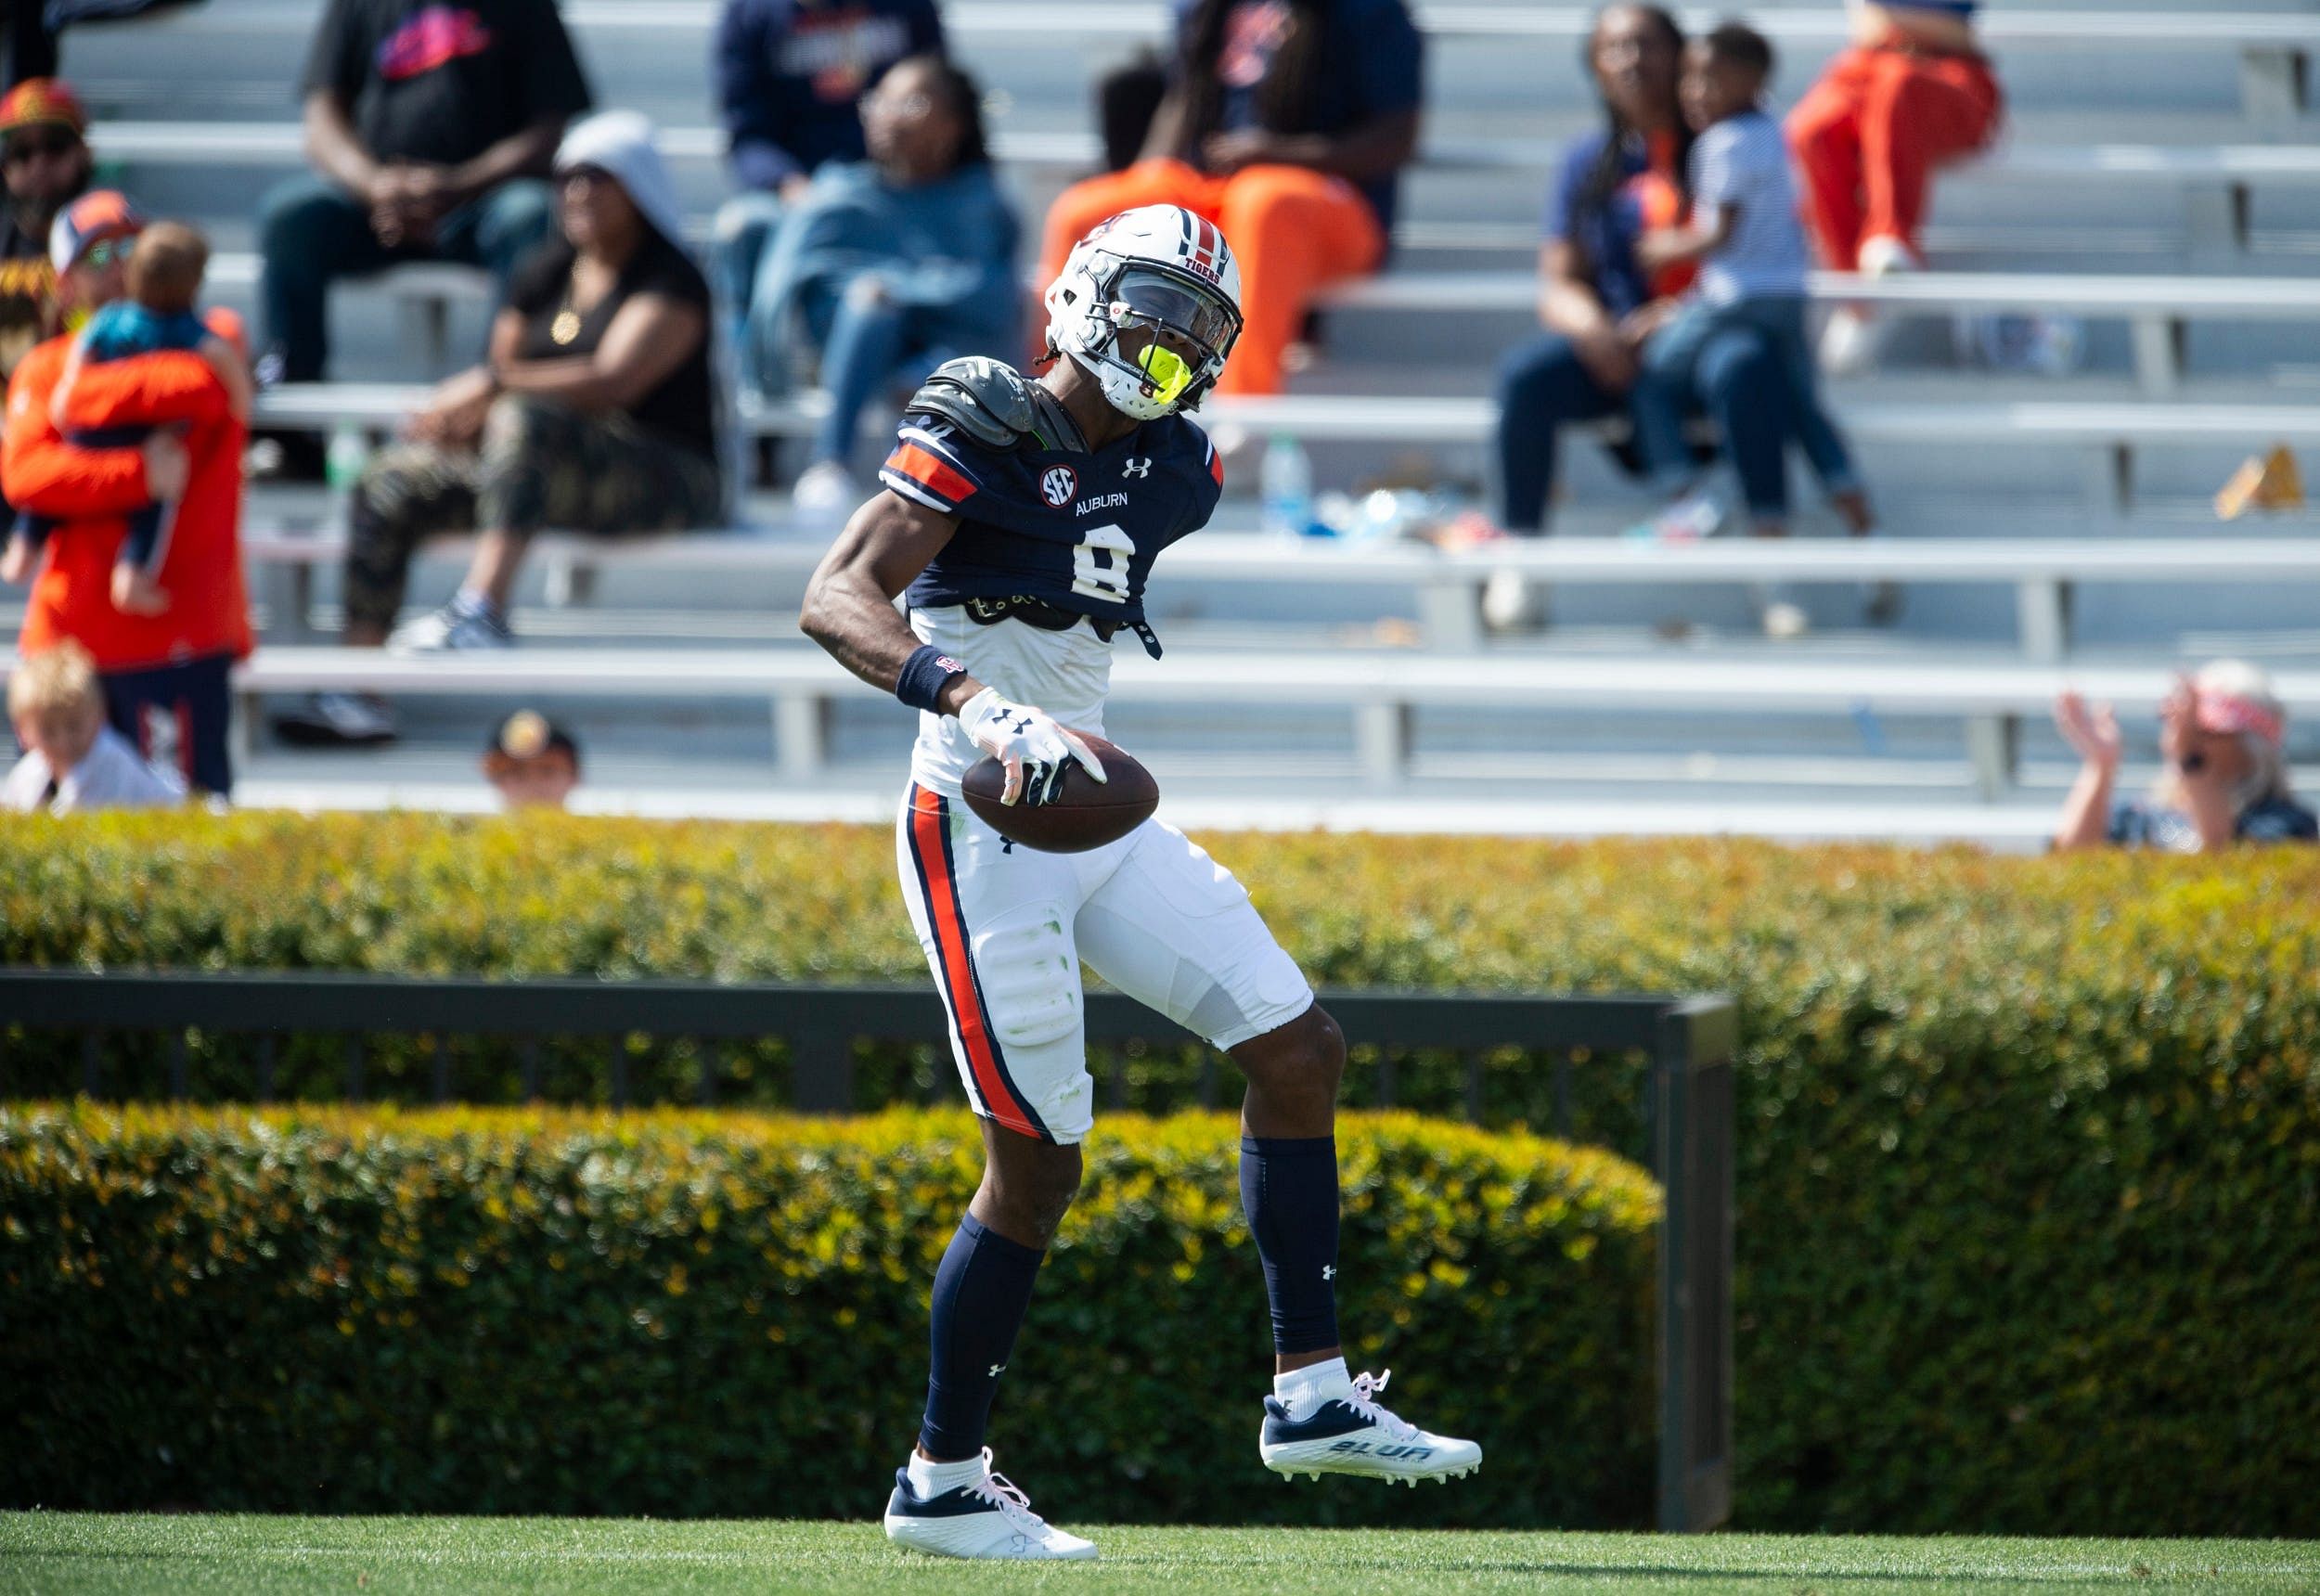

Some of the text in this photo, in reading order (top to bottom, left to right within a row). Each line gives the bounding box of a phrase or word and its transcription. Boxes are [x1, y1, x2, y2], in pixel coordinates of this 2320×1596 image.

[1185, 257, 1220, 285] TIGERS
[1042, 467, 1076, 506] SEC
[1076, 492, 1128, 517] AUBURN
[1072, 524, 1136, 604] 8
